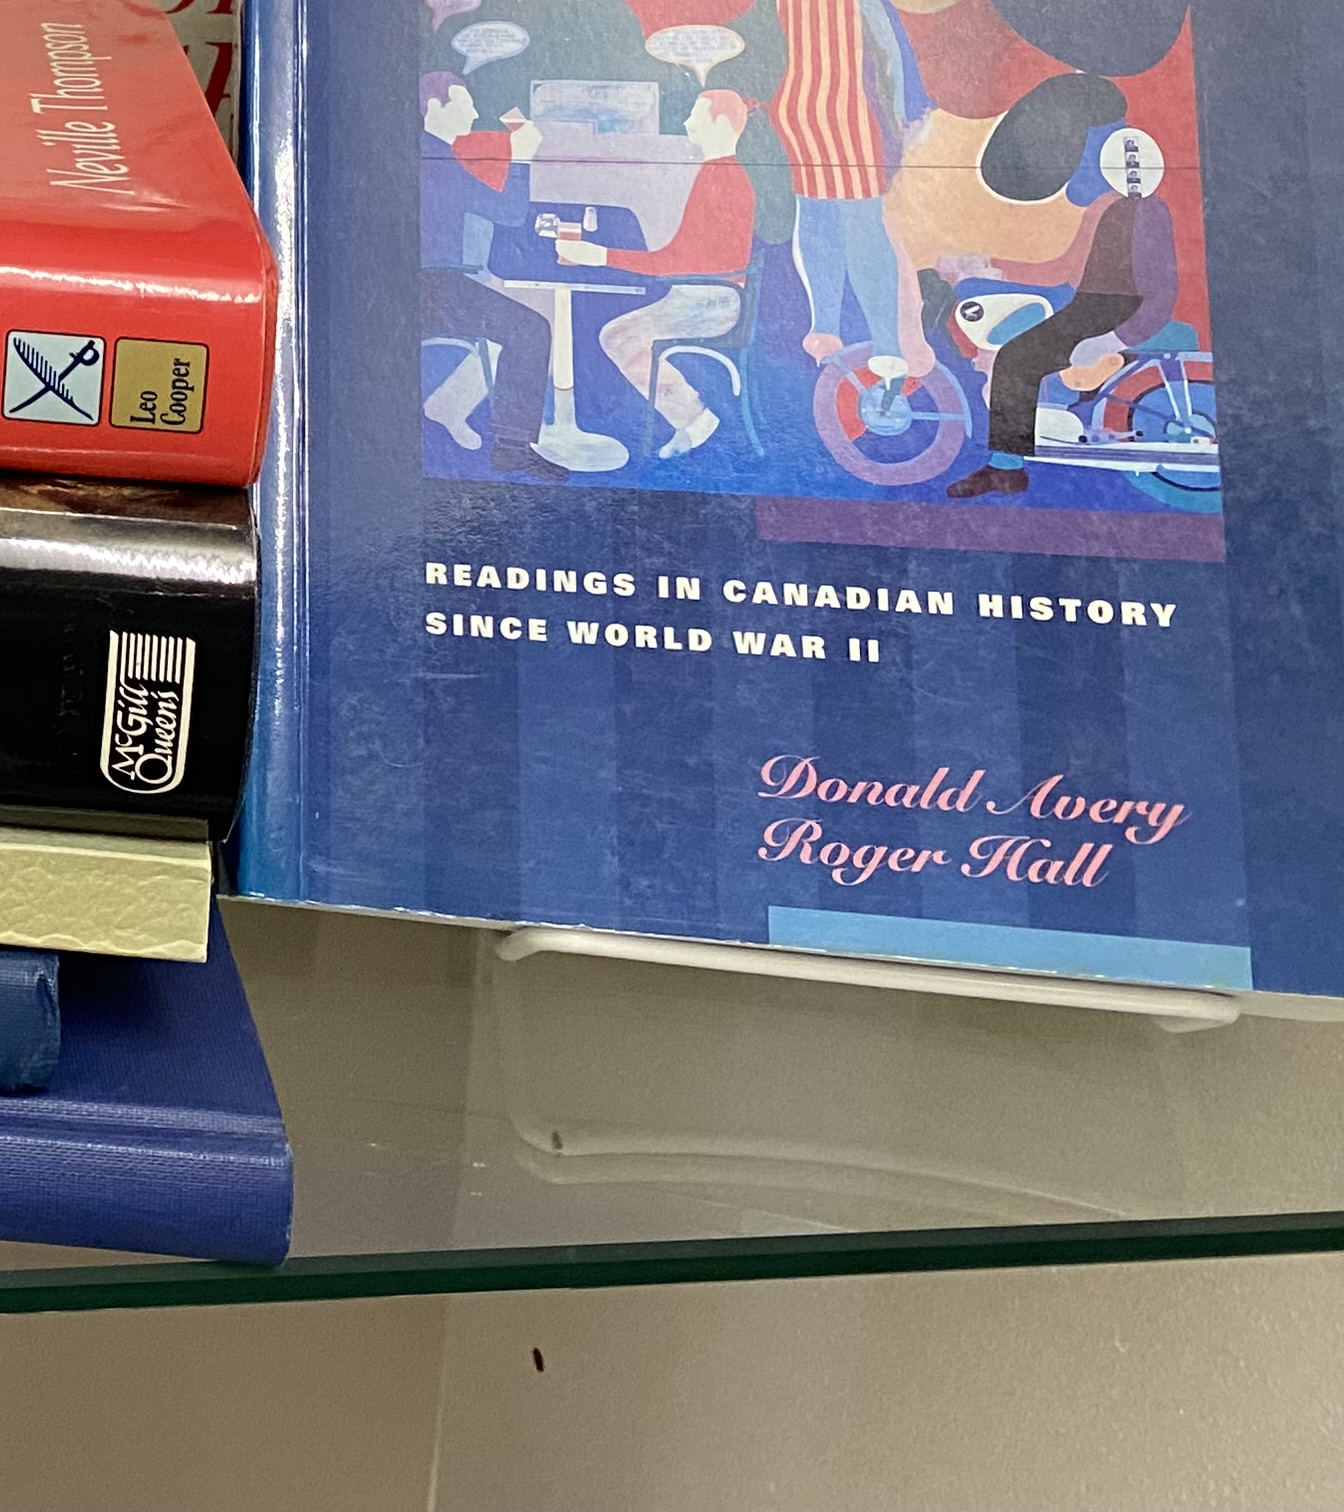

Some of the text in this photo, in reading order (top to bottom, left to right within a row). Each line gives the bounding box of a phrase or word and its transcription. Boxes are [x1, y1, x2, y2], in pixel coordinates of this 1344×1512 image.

[29, 22, 135, 195] Neville Thompson
[130, 390, 158, 425] Leo
[159, 358, 195, 426] Cooper
[426, 562, 1177, 628] READINGS IN CANADIAN HISTORY
[426, 612, 881, 662] SINCE WORLD WAR II
[111, 682, 154, 780] McGill
[135, 690, 179, 784] Queen's
[759, 755, 1189, 846] Donald Avery
[759, 818, 1112, 887] Roger Hall
